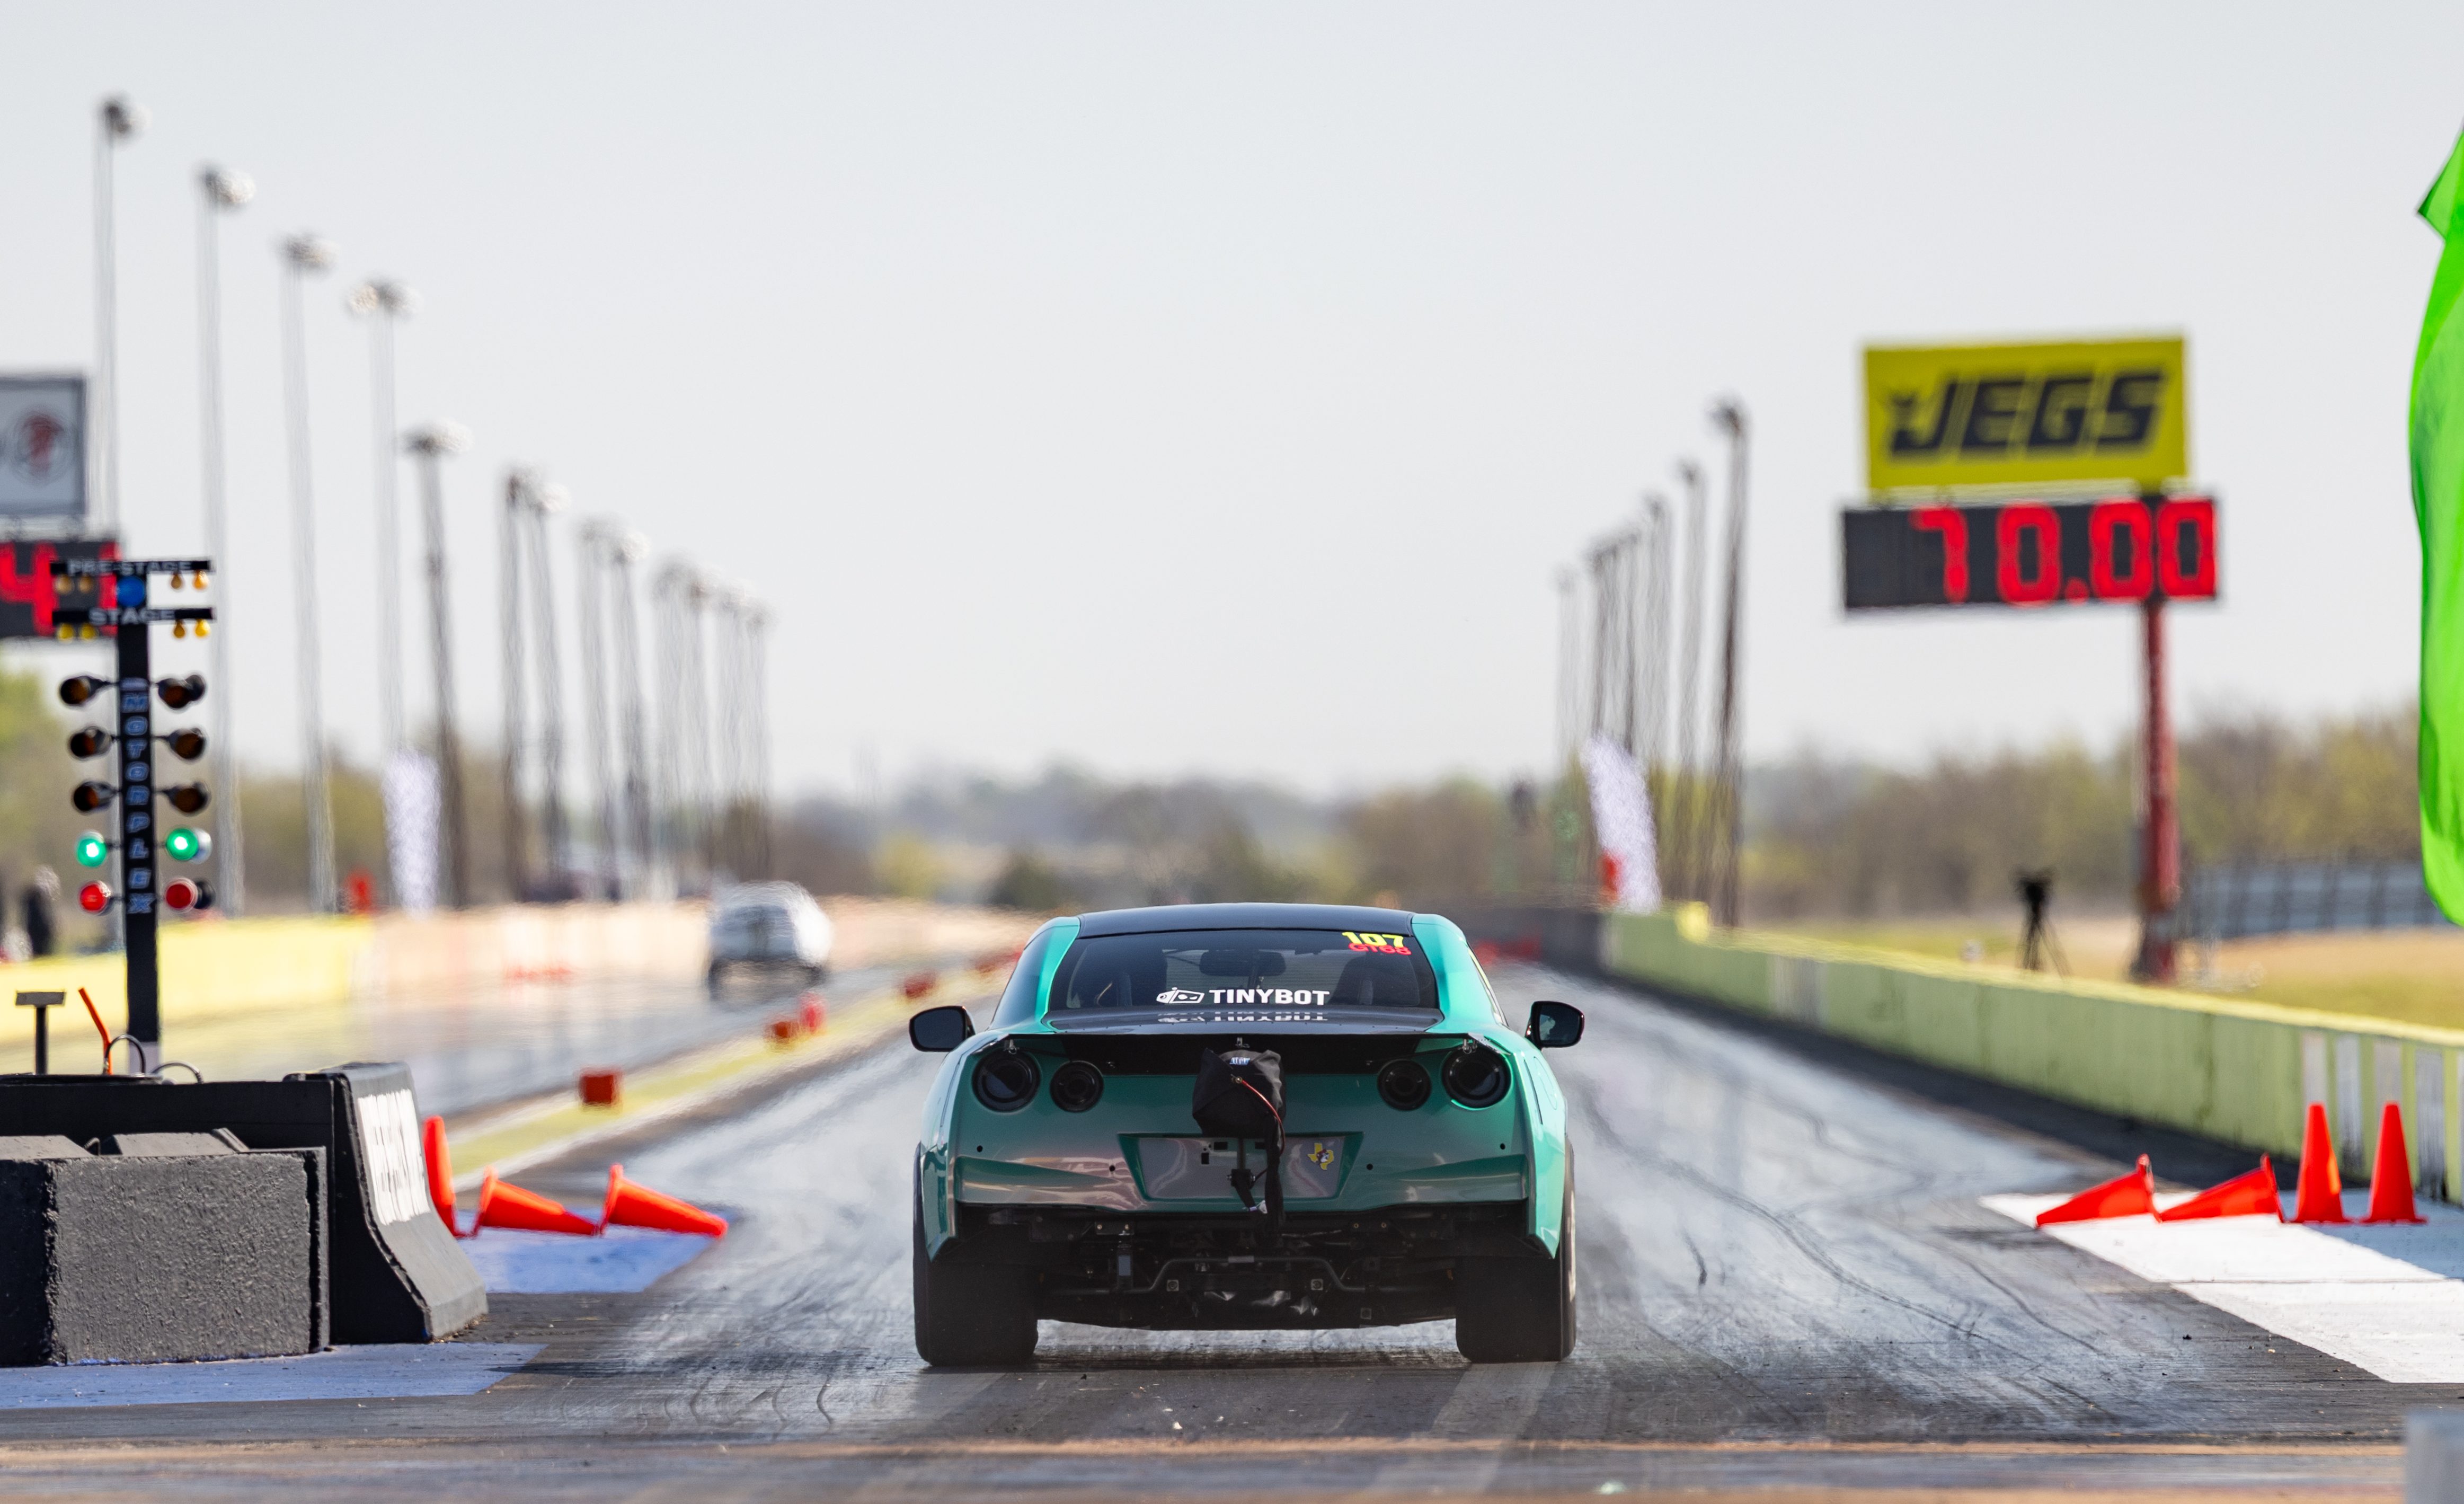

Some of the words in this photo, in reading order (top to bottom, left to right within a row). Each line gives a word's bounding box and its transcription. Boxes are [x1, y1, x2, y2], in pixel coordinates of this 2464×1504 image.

[1889, 367, 2166, 457] JEGS
[1912, 497, 2217, 606] 70.00
[68, 559, 193, 576] PRE-STAGE
[88, 608, 176, 626] STAGE
[121, 693, 153, 914] MOTORPLEX
[1342, 932, 1404, 947] 107
[1209, 989, 1330, 1005] TINYBOT
